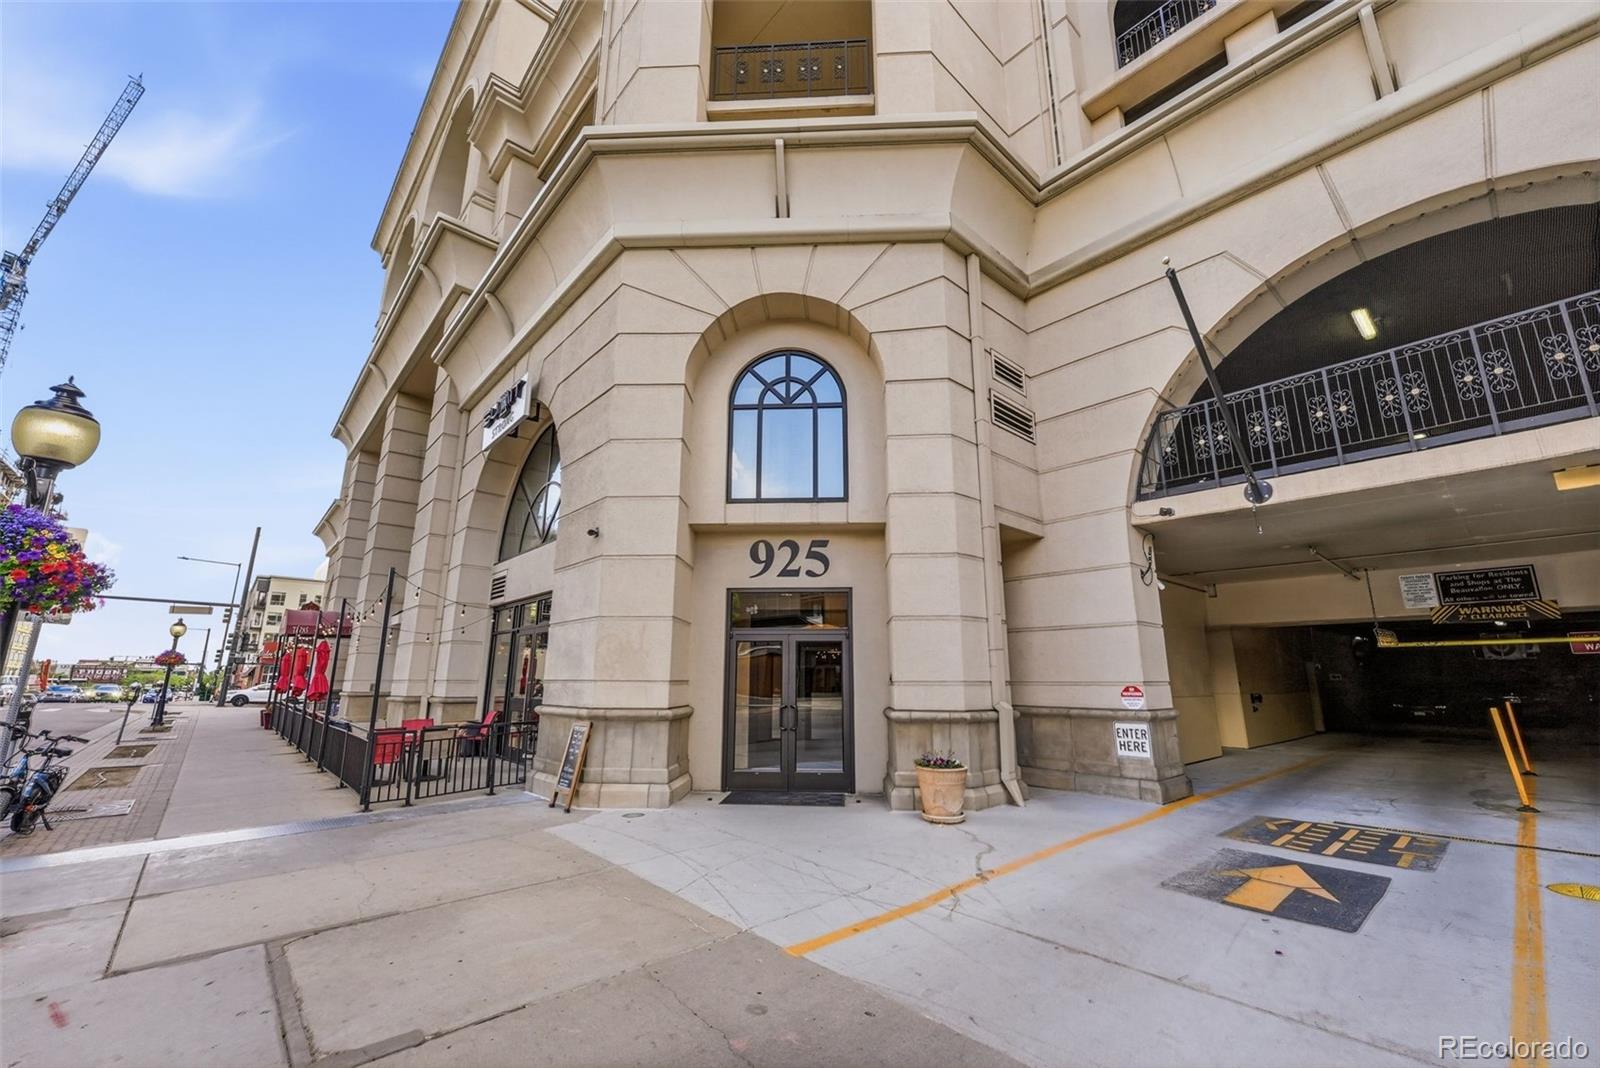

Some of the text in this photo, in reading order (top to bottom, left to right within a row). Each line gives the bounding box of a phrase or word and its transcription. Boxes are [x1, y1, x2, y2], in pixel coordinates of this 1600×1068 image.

[749, 539, 830, 578] 925
[1459, 605, 1526, 614] WARNING
[1471, 611, 1529, 619] CLEARANCE
[1116, 727, 1147, 740] ENTER
[1119, 741, 1147, 753] HERE
